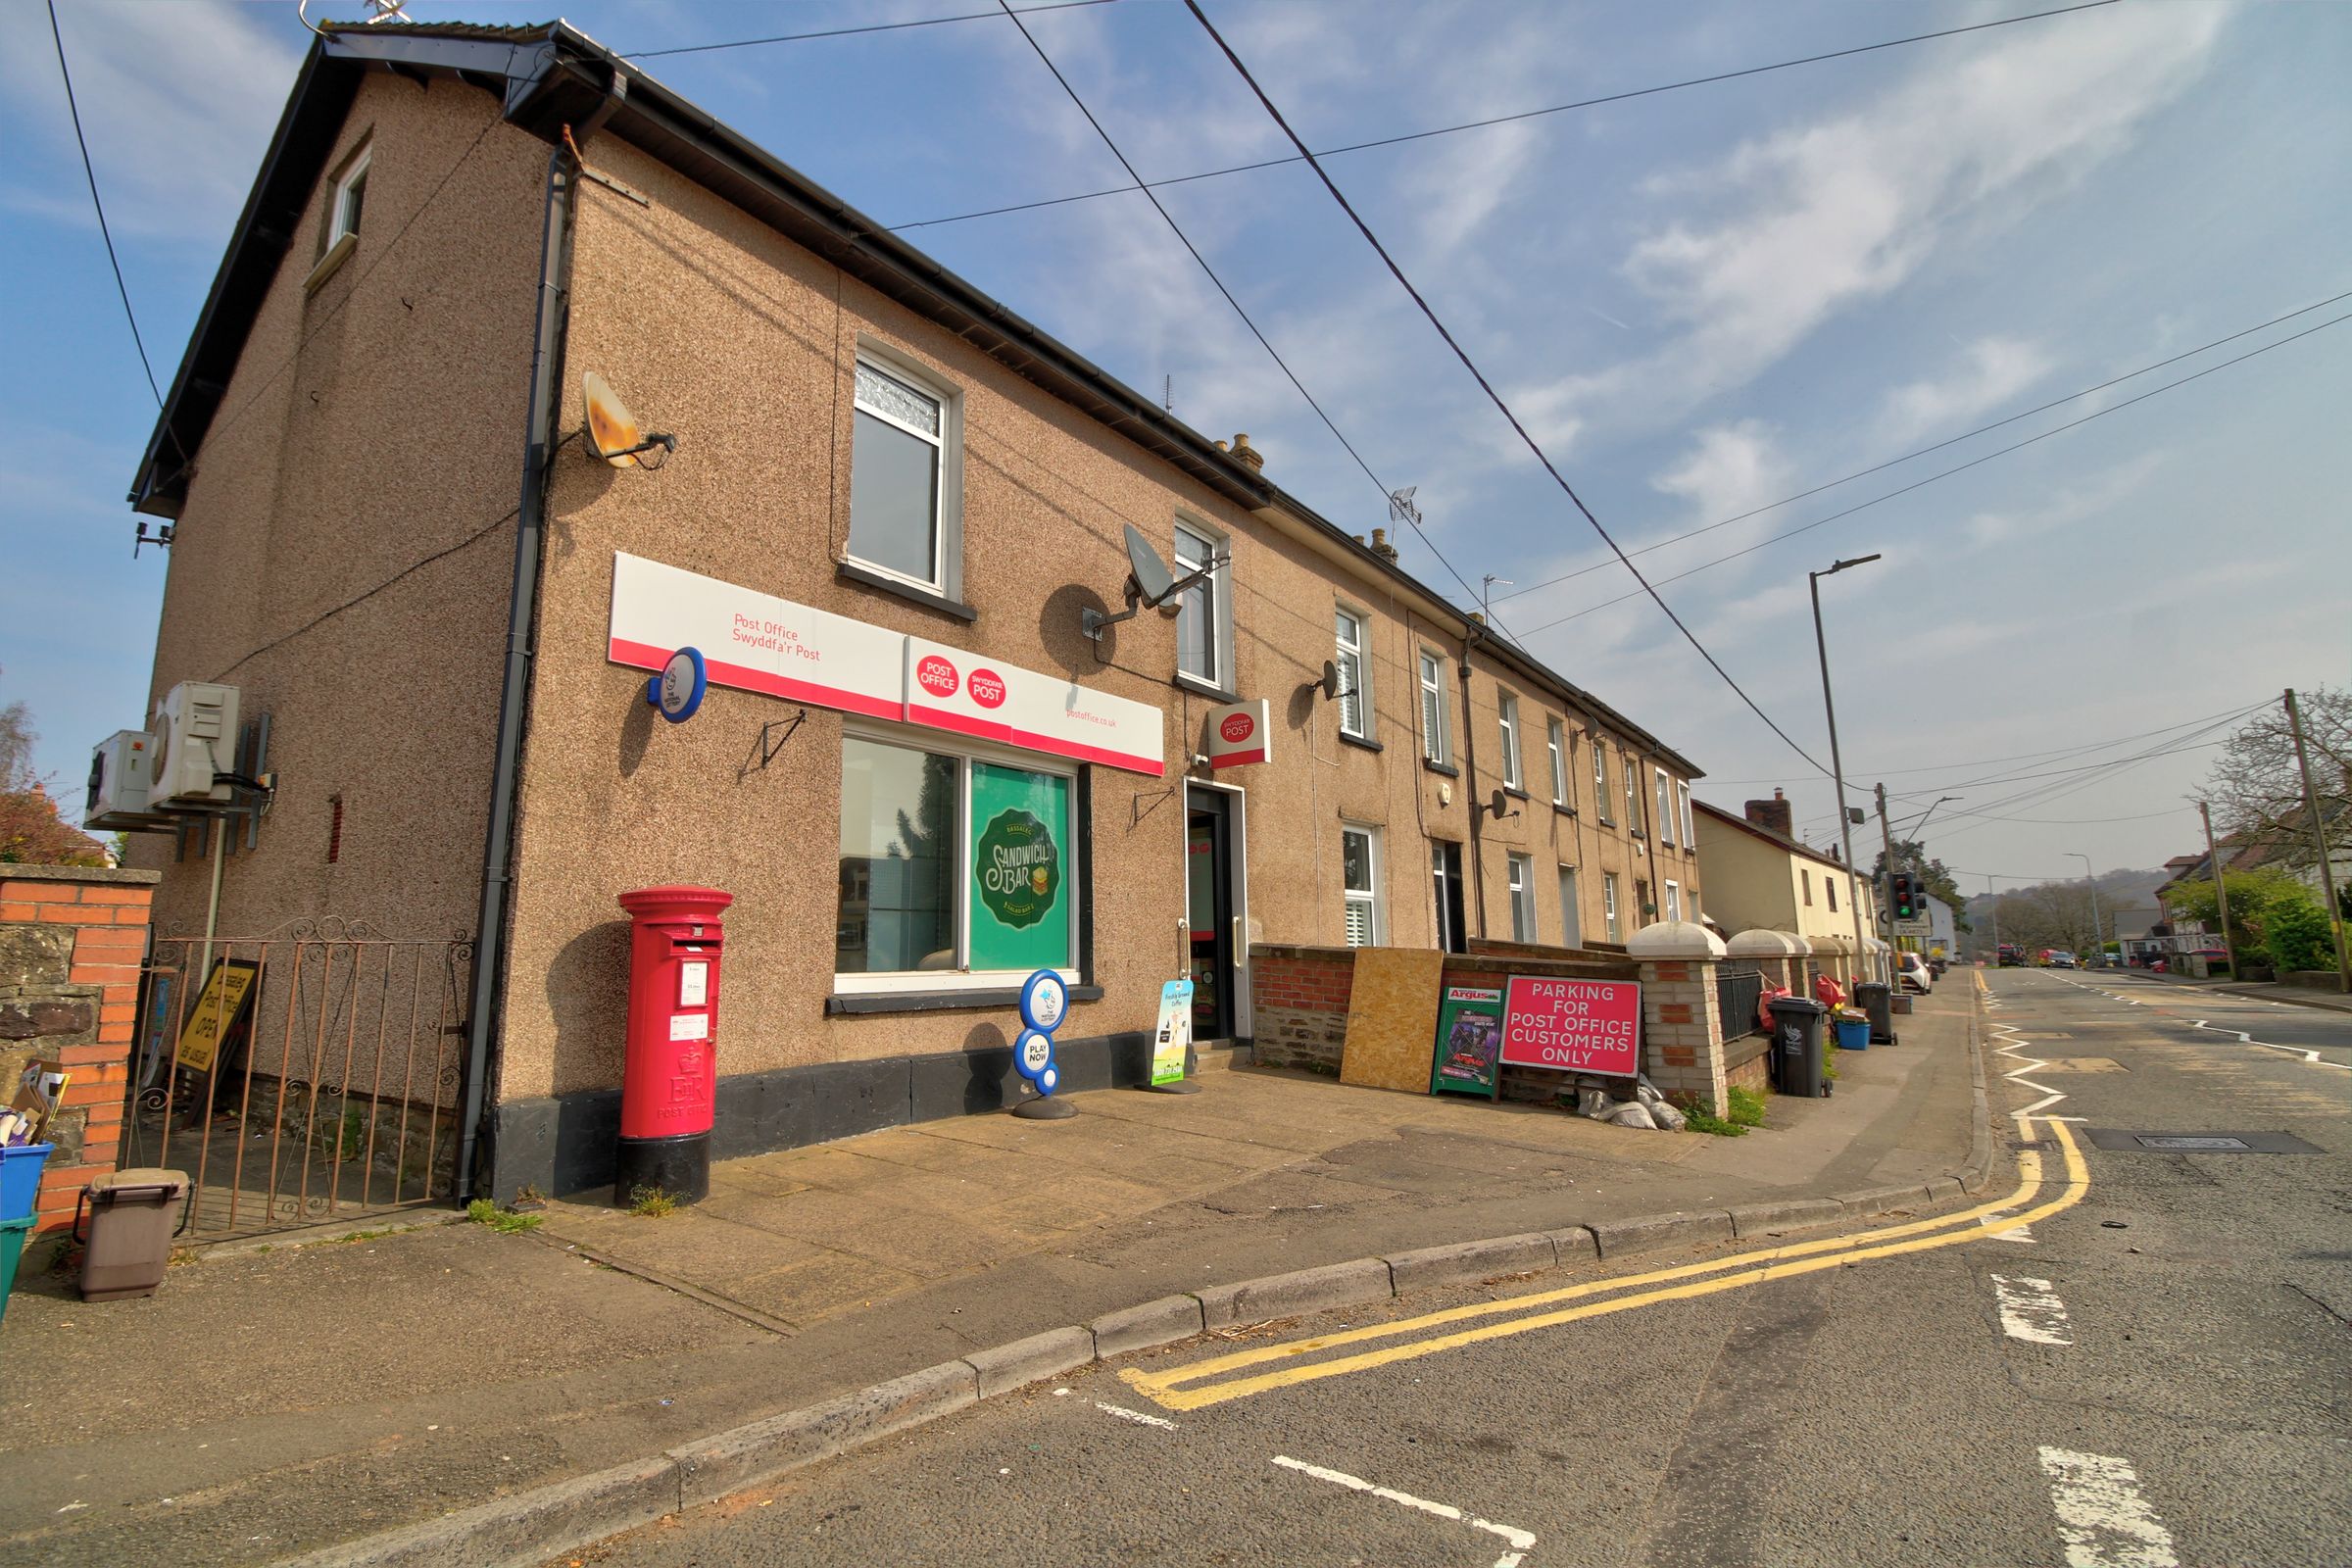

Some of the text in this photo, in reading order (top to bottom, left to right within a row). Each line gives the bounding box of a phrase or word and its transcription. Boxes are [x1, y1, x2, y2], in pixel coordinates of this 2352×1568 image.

[734, 612, 798, 641] Post Office
[732, 628, 821, 662] Swyddfa'r Post
[926, 662, 952, 677] POST
[920, 672, 956, 690] OFFICE
[973, 684, 1002, 701] POST
[1066, 710, 1117, 728] postoffice.co.uk
[1226, 725, 1249, 737] POST
[986, 844, 1049, 891] SANDWICH
[1002, 866, 1031, 894] BAR
[1450, 989, 1488, 1000] Argus
[1532, 983, 1614, 1001] PARKING
[1553, 1000, 1589, 1015] FOR
[1510, 1012, 1632, 1036] POST OFFICE
[1511, 1028, 1628, 1052] CUSTOMERS
[1030, 1045, 1047, 1054] PLAY
[1542, 1047, 1592, 1065] ONLY
